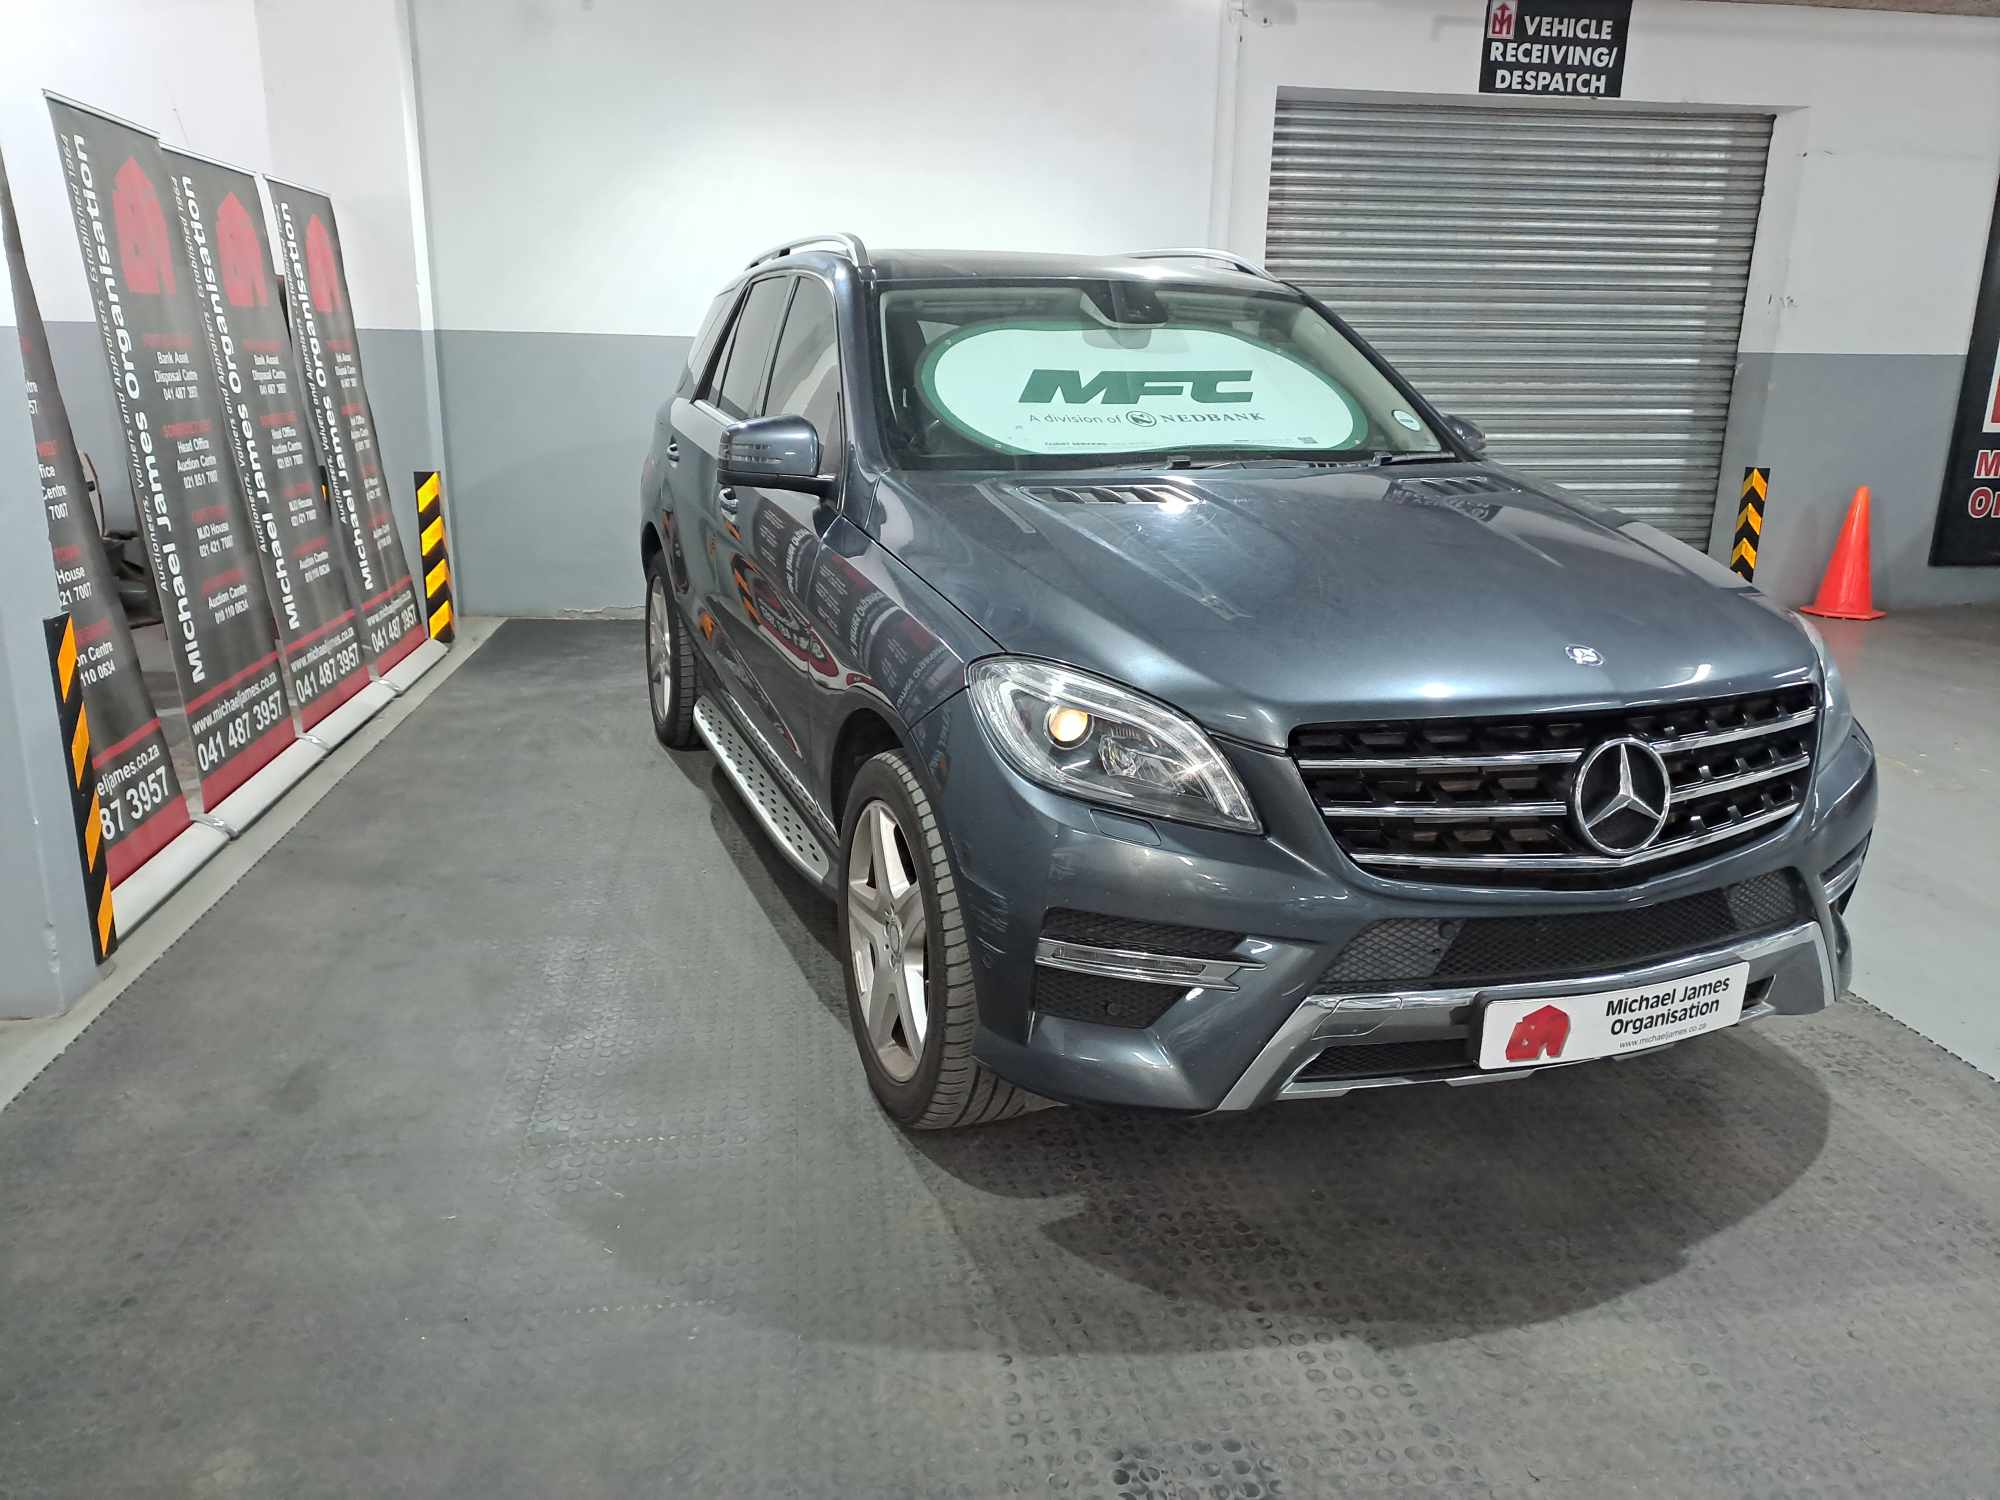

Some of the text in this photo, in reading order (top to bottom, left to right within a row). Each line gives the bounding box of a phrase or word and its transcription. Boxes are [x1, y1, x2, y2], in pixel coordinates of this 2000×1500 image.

[1524, 15, 1613, 40] VEHICLE
[1489, 41, 1618, 68] RECEIVING/
[1495, 69, 1607, 94] DESPATCH
[182, 176, 242, 394] Organisation
[281, 202, 327, 388] Organisation
[1018, 369, 1253, 404] MFC
[73, 134, 206, 684] Michael James Organisation
[116, 391, 131, 425] and
[1028, 411, 1265, 425] A division of NEDBANK
[237, 403, 270, 504] James
[323, 396, 349, 482] James
[342, 489, 374, 590] Michael
[56, 566, 85, 585] House
[262, 512, 300, 630] Michael
[88, 641, 114, 661] Centre
[371, 628, 389, 653] 041
[295, 642, 360, 703] 041 487 3957
[197, 690, 282, 771] 041 487 3957
[99, 765, 169, 840] 87 3957
[1606, 977, 1730, 1017] Michael James
[1610, 999, 1720, 1035] Organisation
